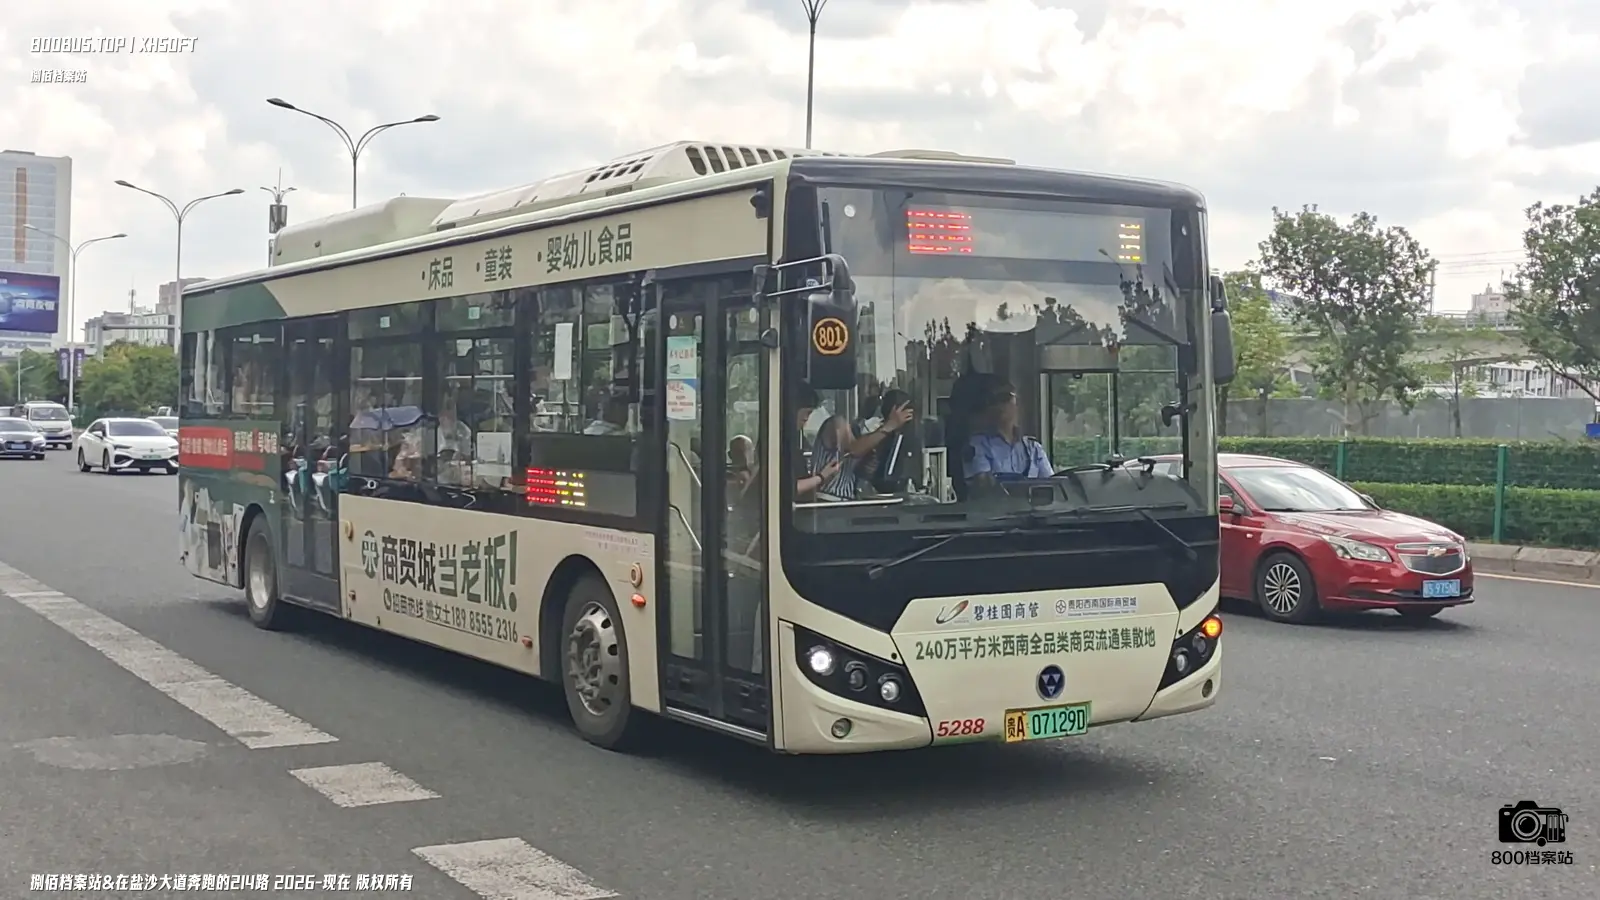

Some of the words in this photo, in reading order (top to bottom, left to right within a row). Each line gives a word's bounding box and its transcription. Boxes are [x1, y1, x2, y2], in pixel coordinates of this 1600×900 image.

[819, 326, 843, 347] 801
[495, 617, 519, 643] 2316
[915, 625, 1157, 661] 240万平方米西南全品类商贸流通集散地
[936, 718, 986, 738] 5288
